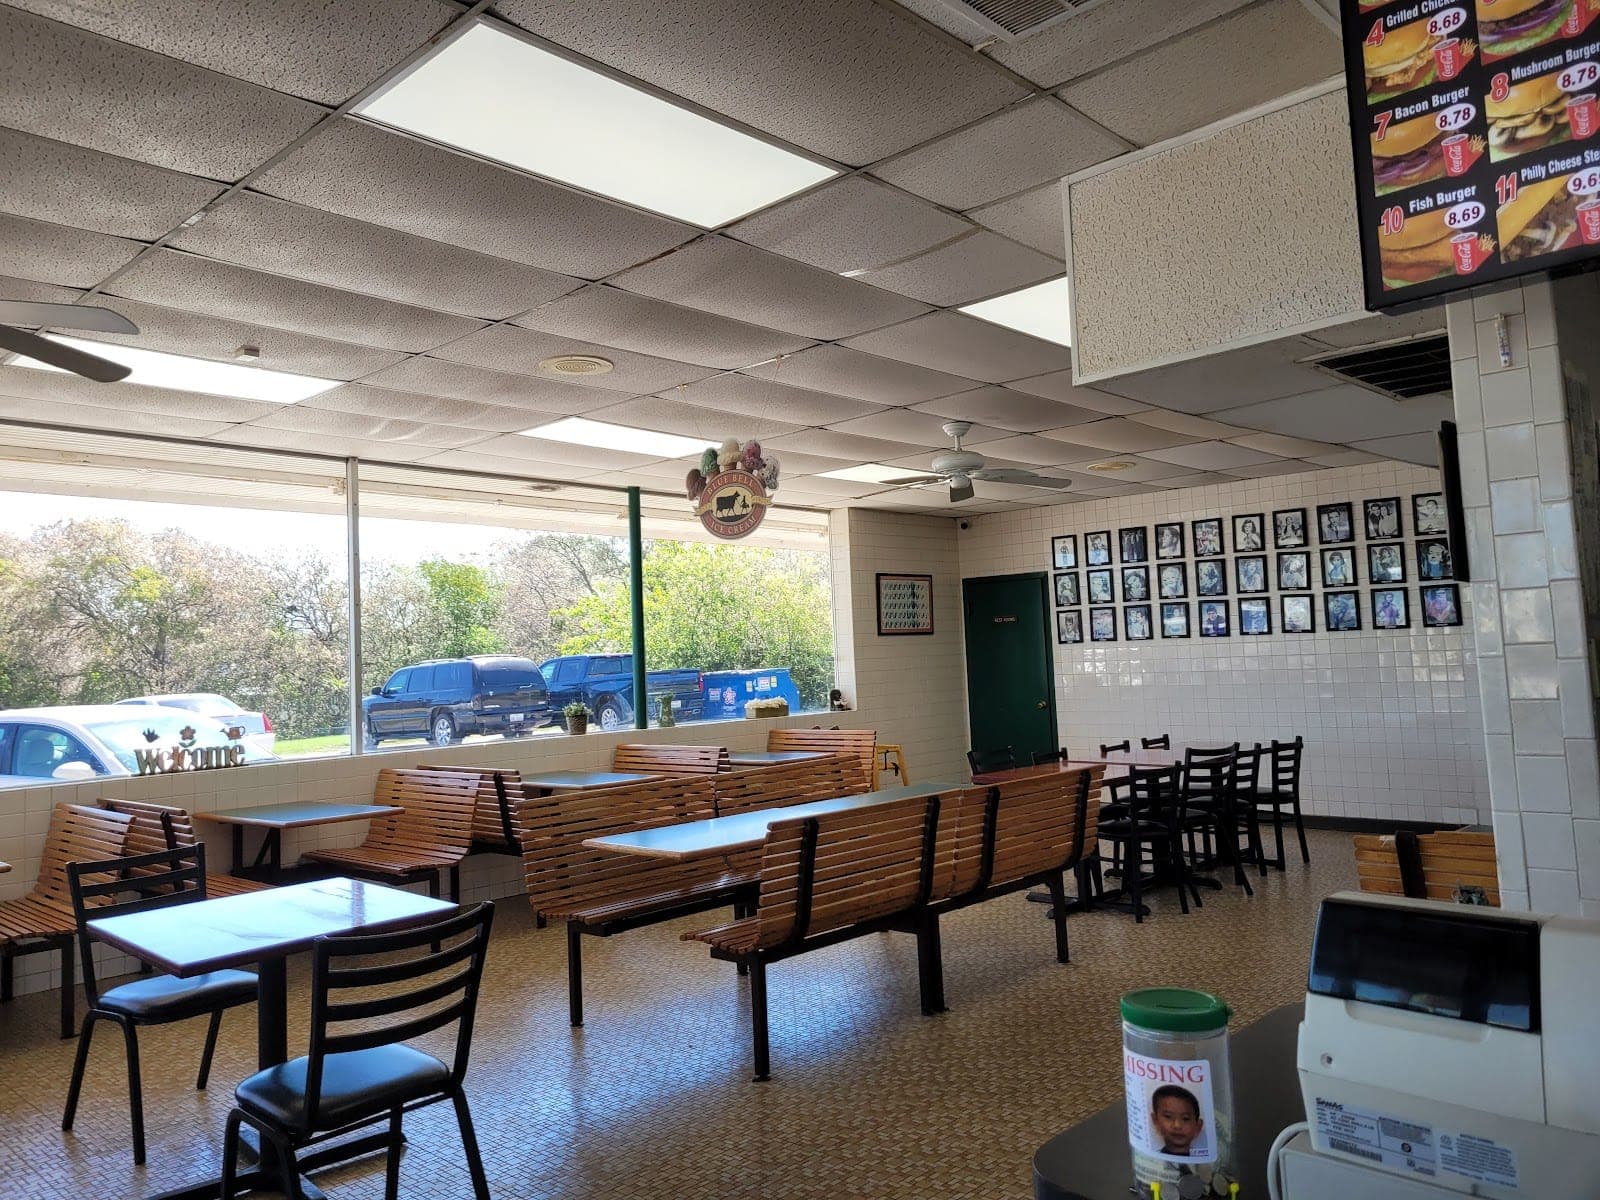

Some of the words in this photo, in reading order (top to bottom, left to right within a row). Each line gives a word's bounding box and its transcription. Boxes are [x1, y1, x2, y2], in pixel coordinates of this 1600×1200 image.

[1386, 4, 1419, 28] Grilled
[1429, 12, 1461, 34] 8.68
[1366, 17, 1385, 47] 4
[1511, 55, 1563, 81] Mushroom
[1565, 41, 1600, 63] Burger
[1490, 72, 1510, 103] 8
[1562, 65, 1597, 88] 8.78
[1394, 101, 1429, 120] Bacon
[1431, 86, 1470, 108] Burger
[1439, 107, 1471, 129] 8.78
[1374, 110, 1393, 142] 7
[1520, 164, 1547, 182] Philly
[1548, 155, 1582, 174] Cheese
[1584, 149, 1600, 164] Ste
[1409, 197, 1433, 213] Fish
[1436, 185, 1477, 206] Burger
[1495, 172, 1518, 205] 11
[1381, 205, 1404, 236] 10
[1448, 206, 1480, 226] 8.69
